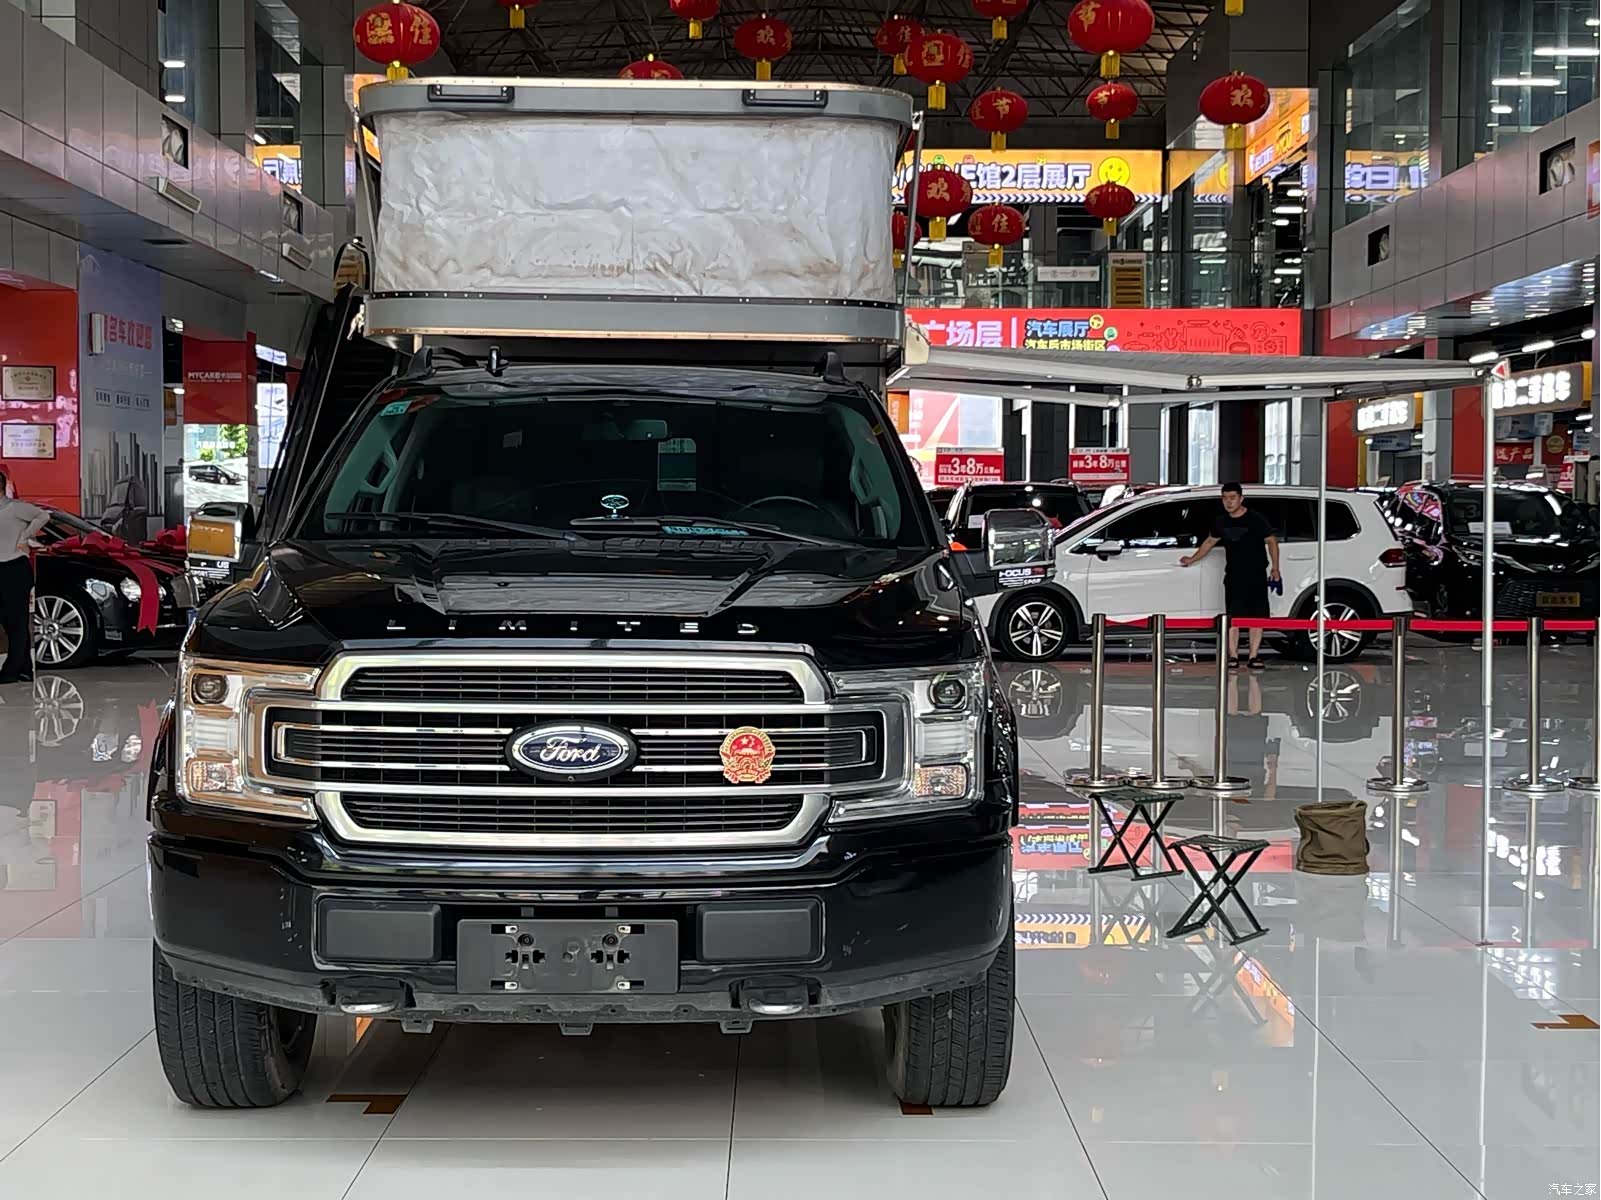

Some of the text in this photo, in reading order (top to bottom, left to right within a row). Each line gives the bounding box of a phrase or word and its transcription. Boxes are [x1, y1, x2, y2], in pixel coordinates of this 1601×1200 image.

[1026, 319, 1090, 338] 汽车展厅
[386, 619, 760, 635] LIMITED
[539, 736, 602, 763] Ford
